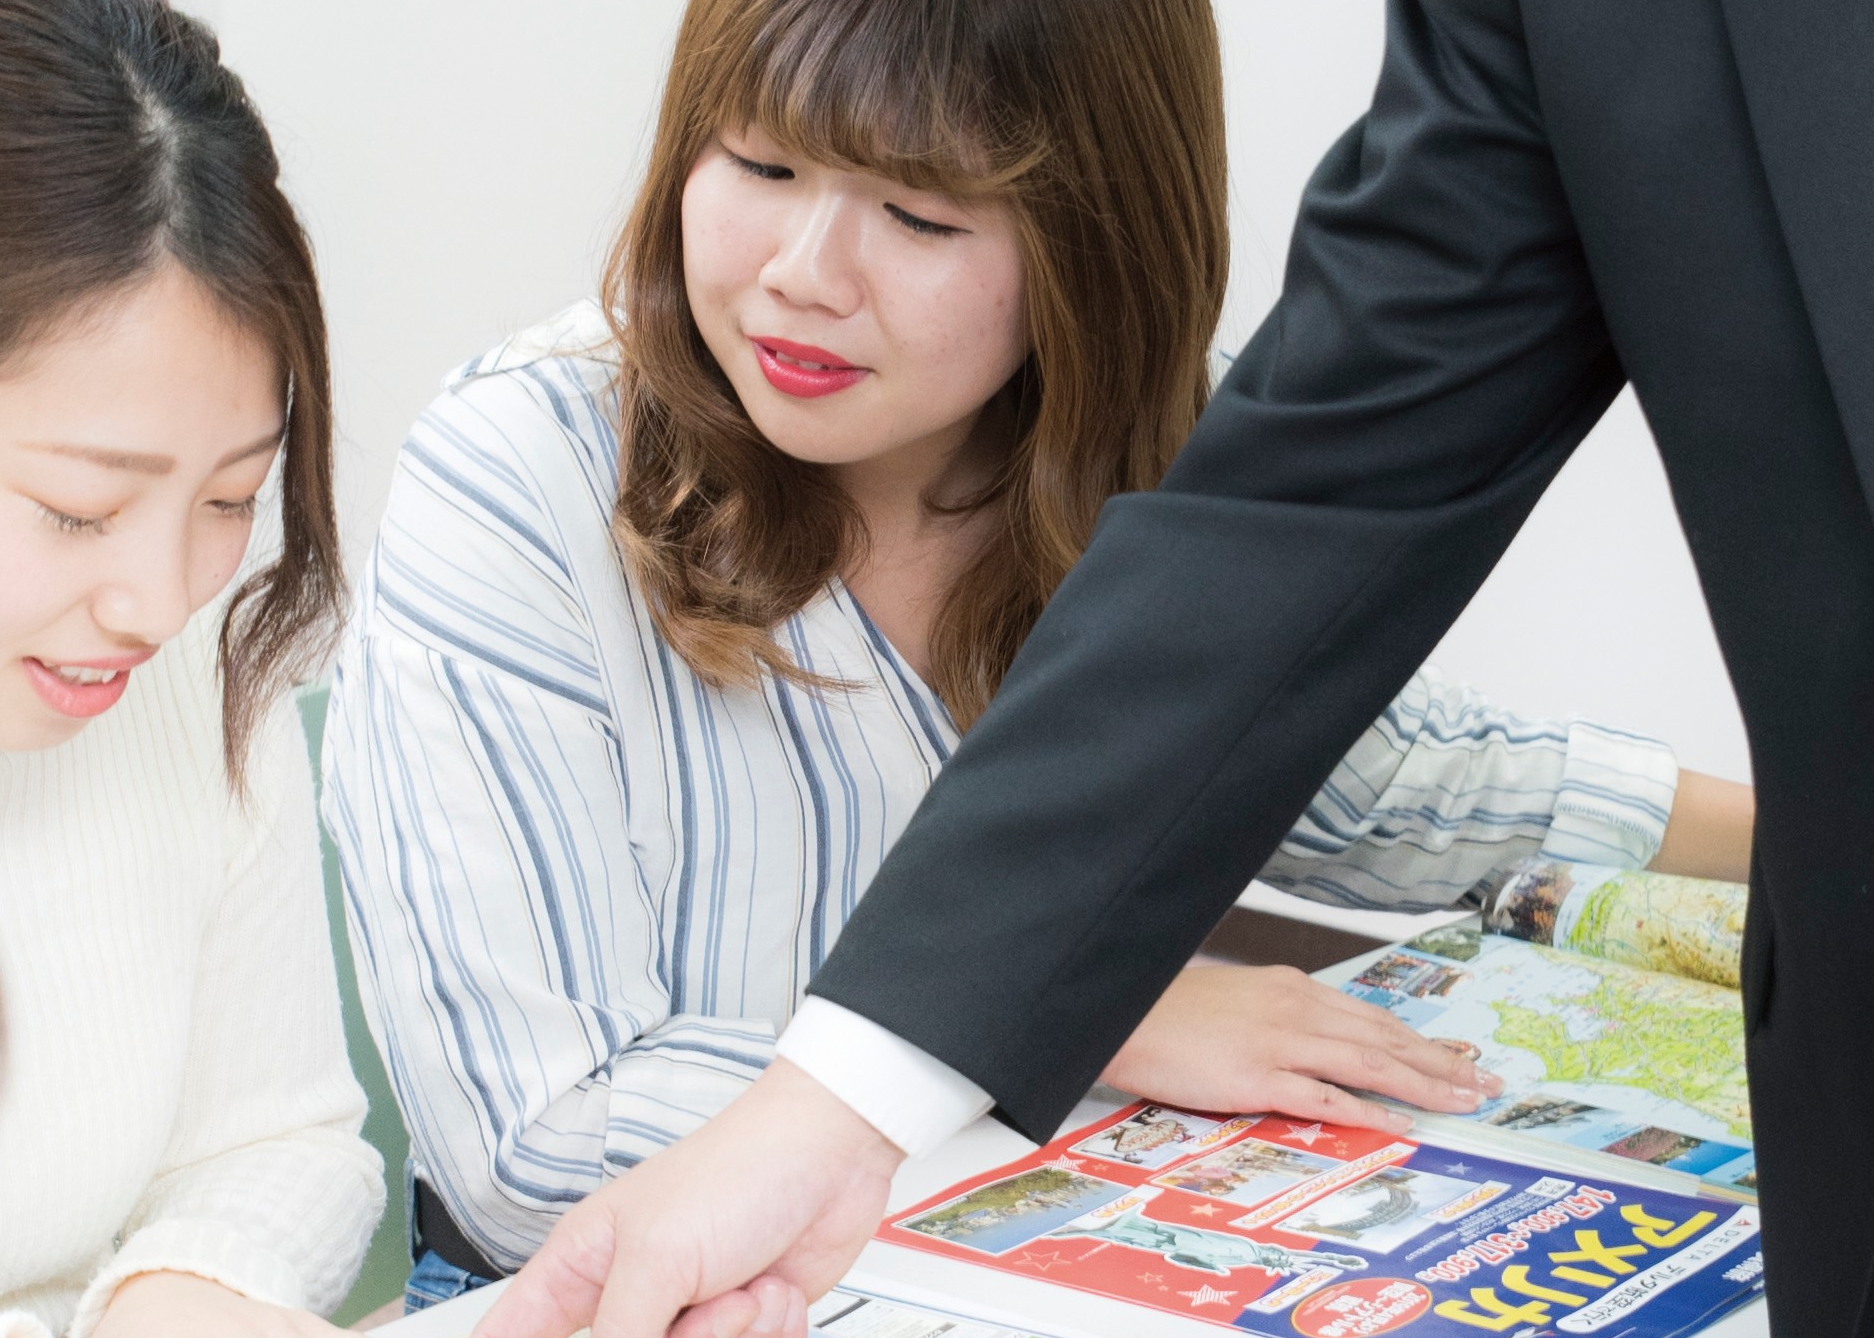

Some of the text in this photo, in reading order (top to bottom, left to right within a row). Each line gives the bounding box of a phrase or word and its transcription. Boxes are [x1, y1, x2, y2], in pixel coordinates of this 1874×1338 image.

[1433, 1203, 1718, 1332] アメリカ
[1688, 1230, 1741, 1261] DELTA
